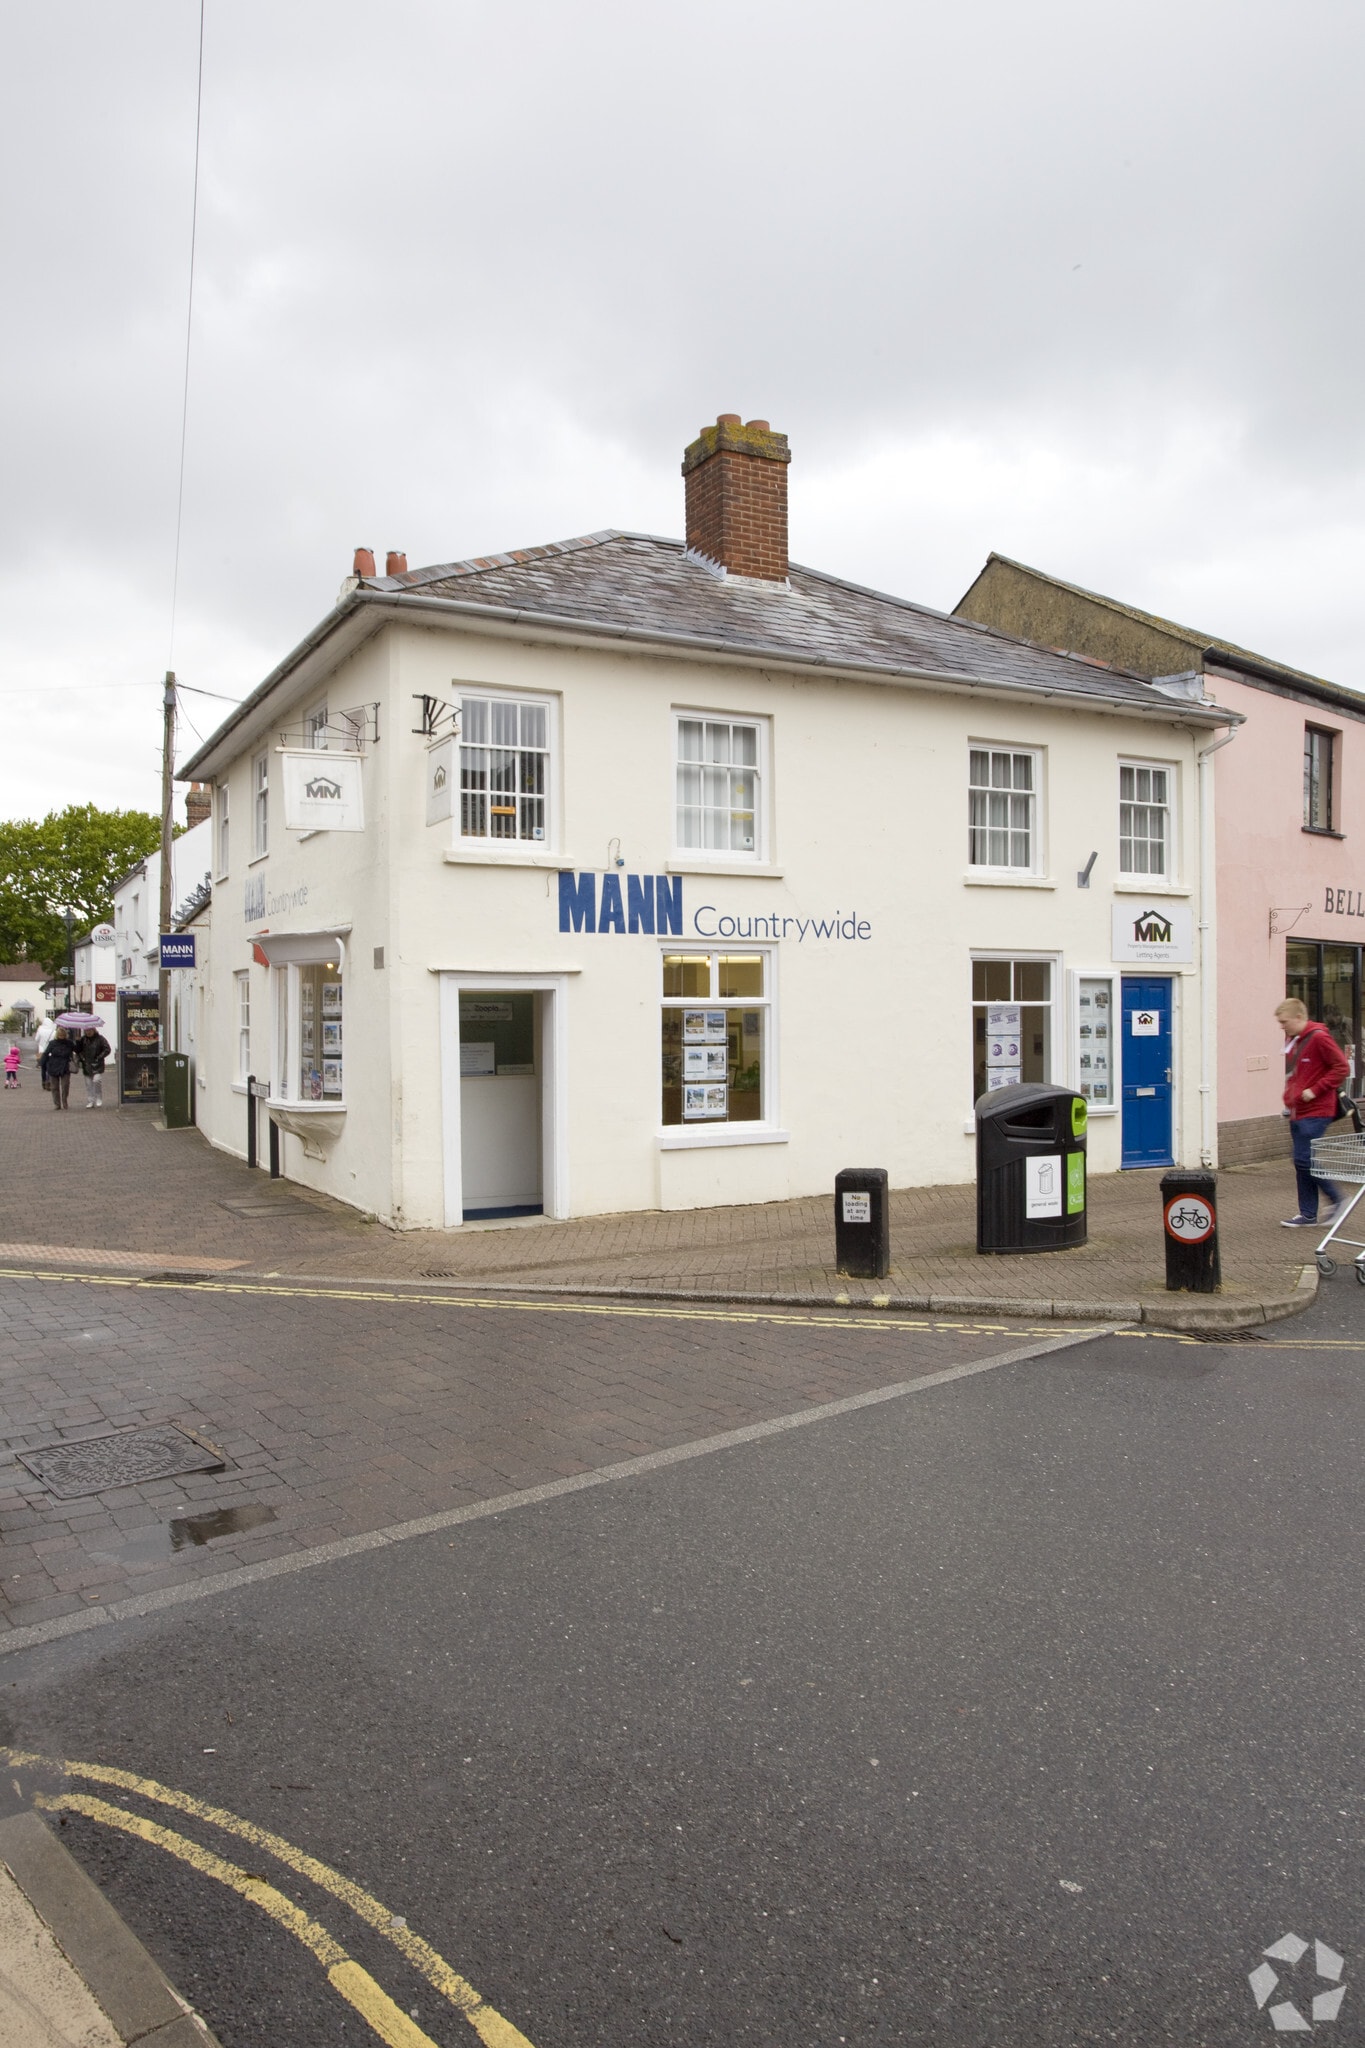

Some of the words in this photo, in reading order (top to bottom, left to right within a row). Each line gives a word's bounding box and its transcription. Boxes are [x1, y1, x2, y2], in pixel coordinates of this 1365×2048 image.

[306, 784, 341, 799] MM
[558, 871, 683, 936] MANN
[694, 906, 872, 943] Countrywide
[1325, 887, 1365, 917] BELL
[1134, 922, 1171, 942] MM
[162, 945, 193, 954] MANN
